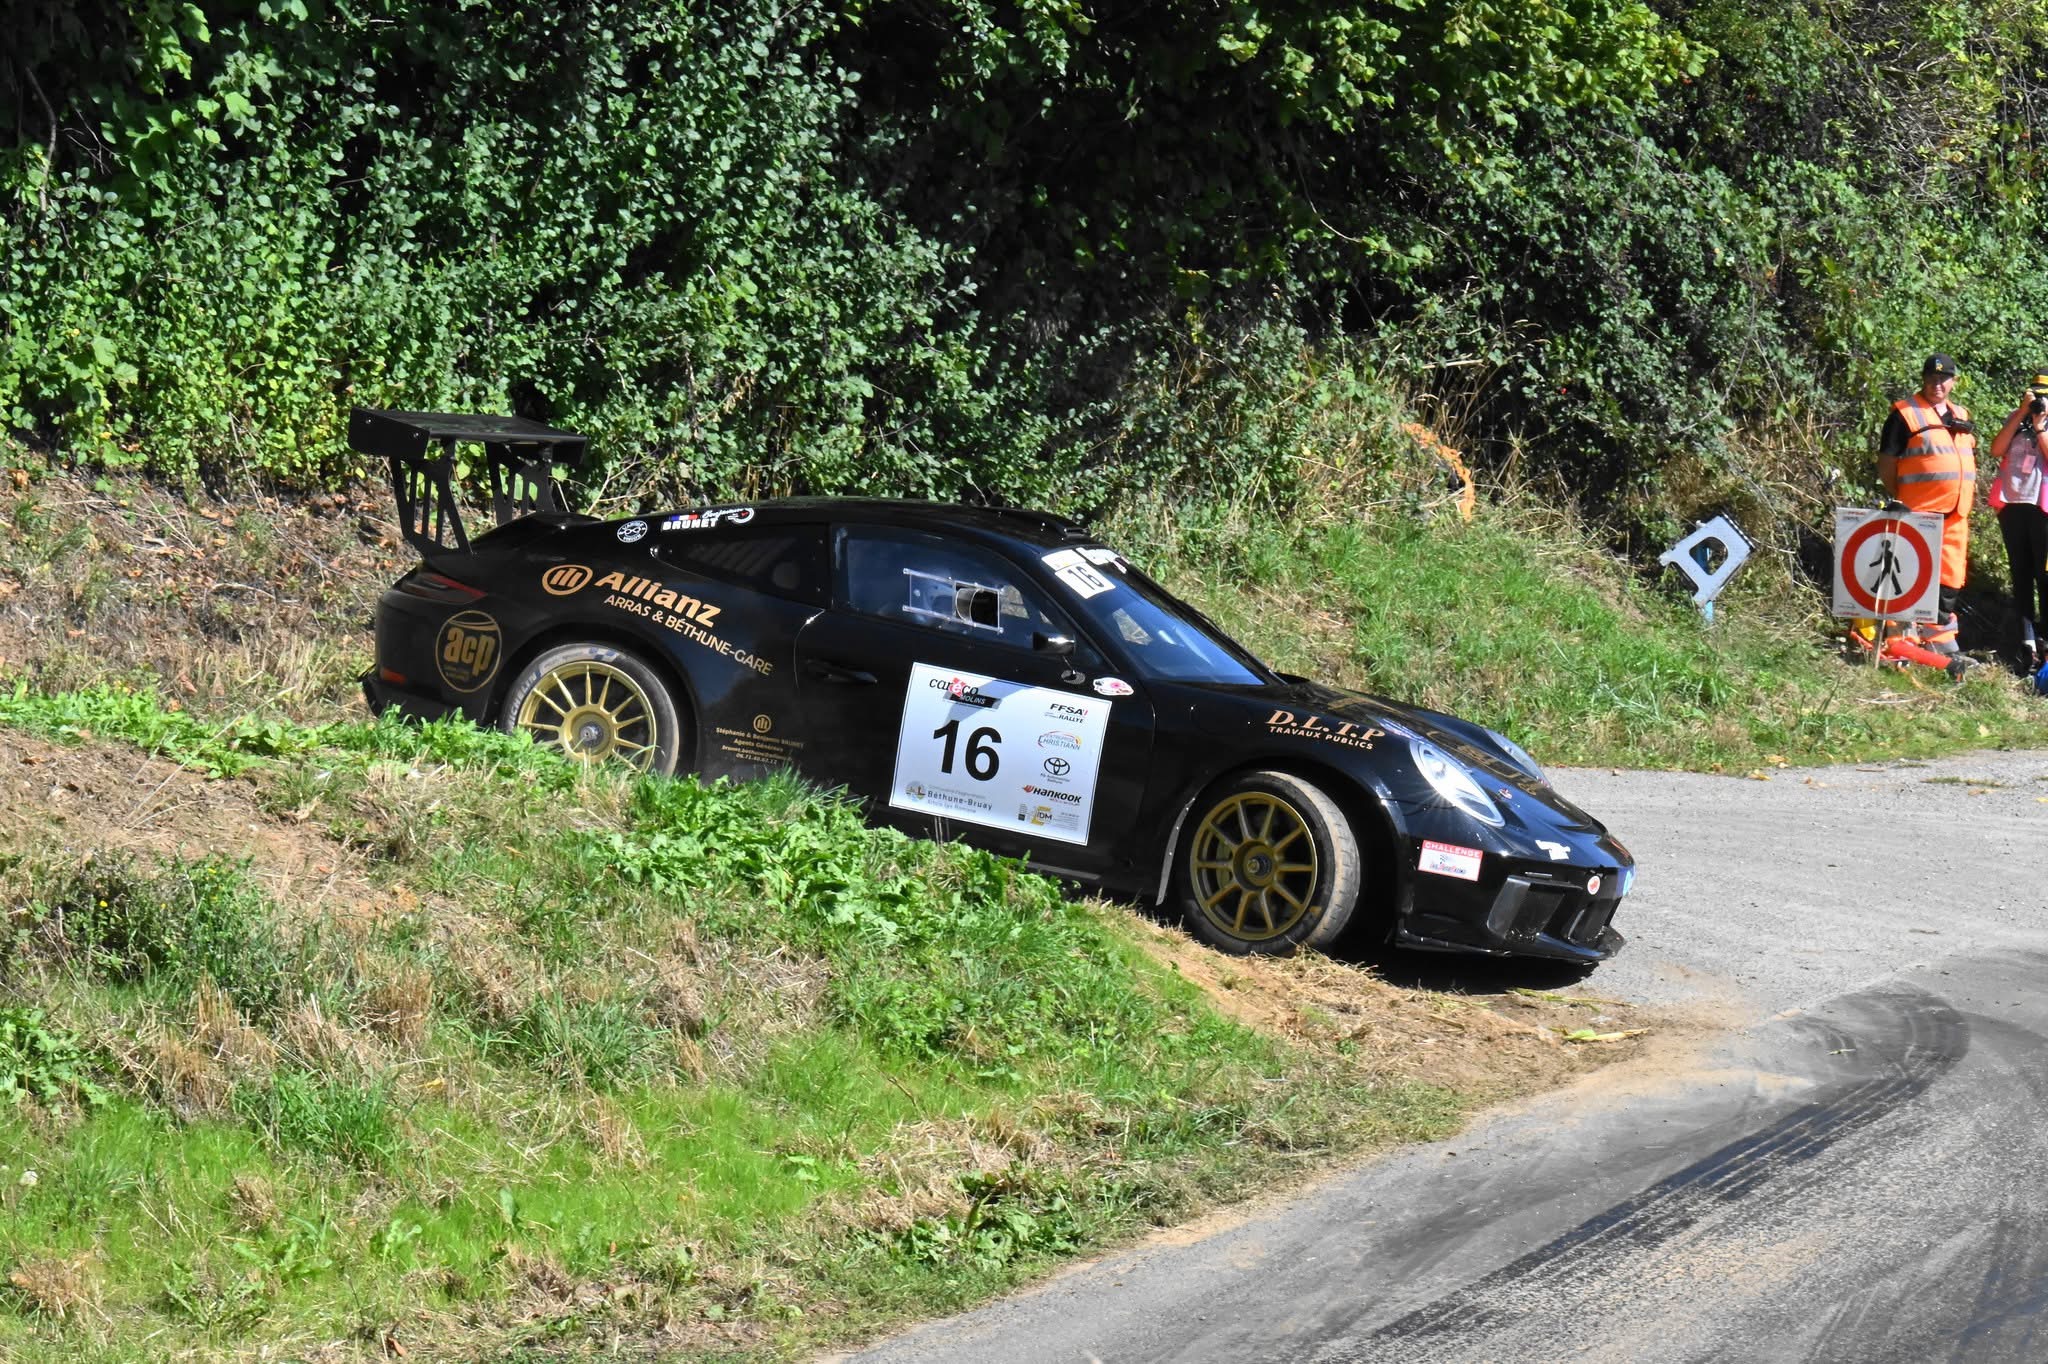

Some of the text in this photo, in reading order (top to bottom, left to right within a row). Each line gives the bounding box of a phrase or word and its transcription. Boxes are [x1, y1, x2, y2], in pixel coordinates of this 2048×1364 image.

[662, 519, 719, 531] BRUNET
[1067, 565, 1105, 591] 16
[594, 571, 722, 628] Allianz
[603, 594, 774, 676] ARRAS & BÉTHUNE-GARE
[444, 627, 496, 677] acp
[1050, 703, 1083, 716] FFSA
[1058, 714, 1084, 724] RALLYE
[933, 719, 1002, 782] 16
[1269, 726, 1374, 750] TRAVAUX PUBLICS
[1424, 841, 1481, 858] CHALLENGE
